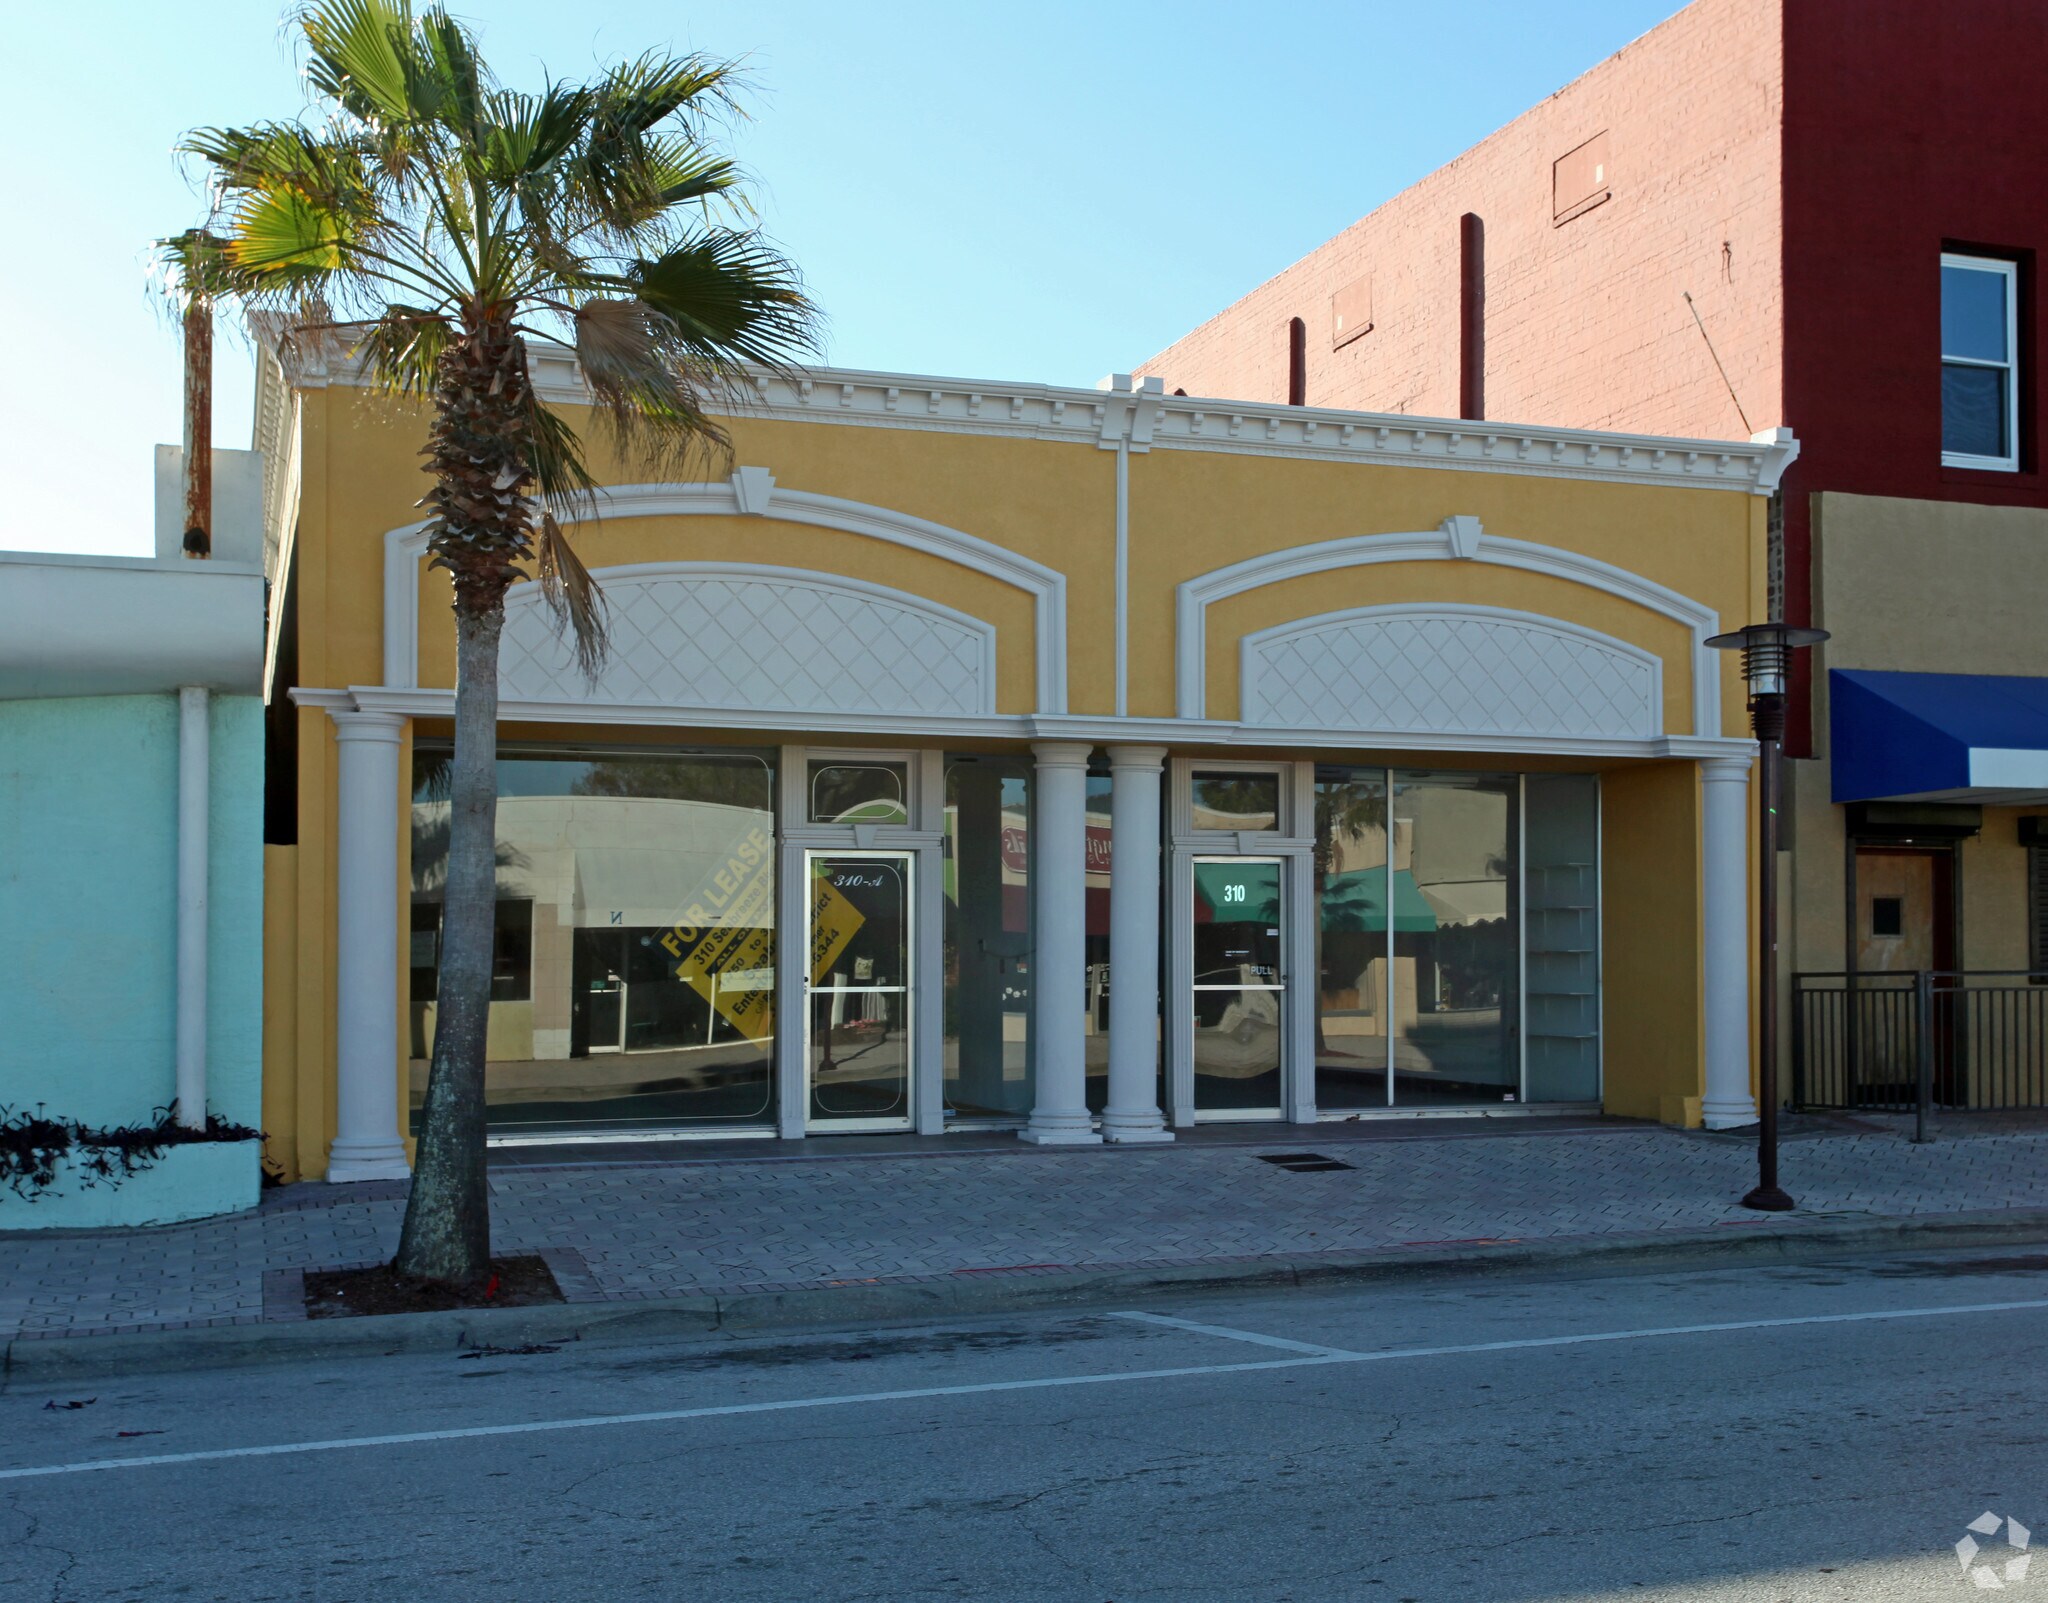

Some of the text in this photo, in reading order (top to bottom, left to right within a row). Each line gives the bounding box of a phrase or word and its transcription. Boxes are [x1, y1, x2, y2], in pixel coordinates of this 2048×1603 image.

[834, 875, 883, 887] 310-A
[660, 904, 714, 957] FOR
[703, 827, 769, 908] LEASE
[1224, 885, 1245, 902] 310
[693, 942, 715, 965] 310
[712, 888, 761, 943] Seabreeze
[749, 938, 762, 951] to
[716, 944, 737, 968] ALL
[1250, 966, 1273, 976] PULL
